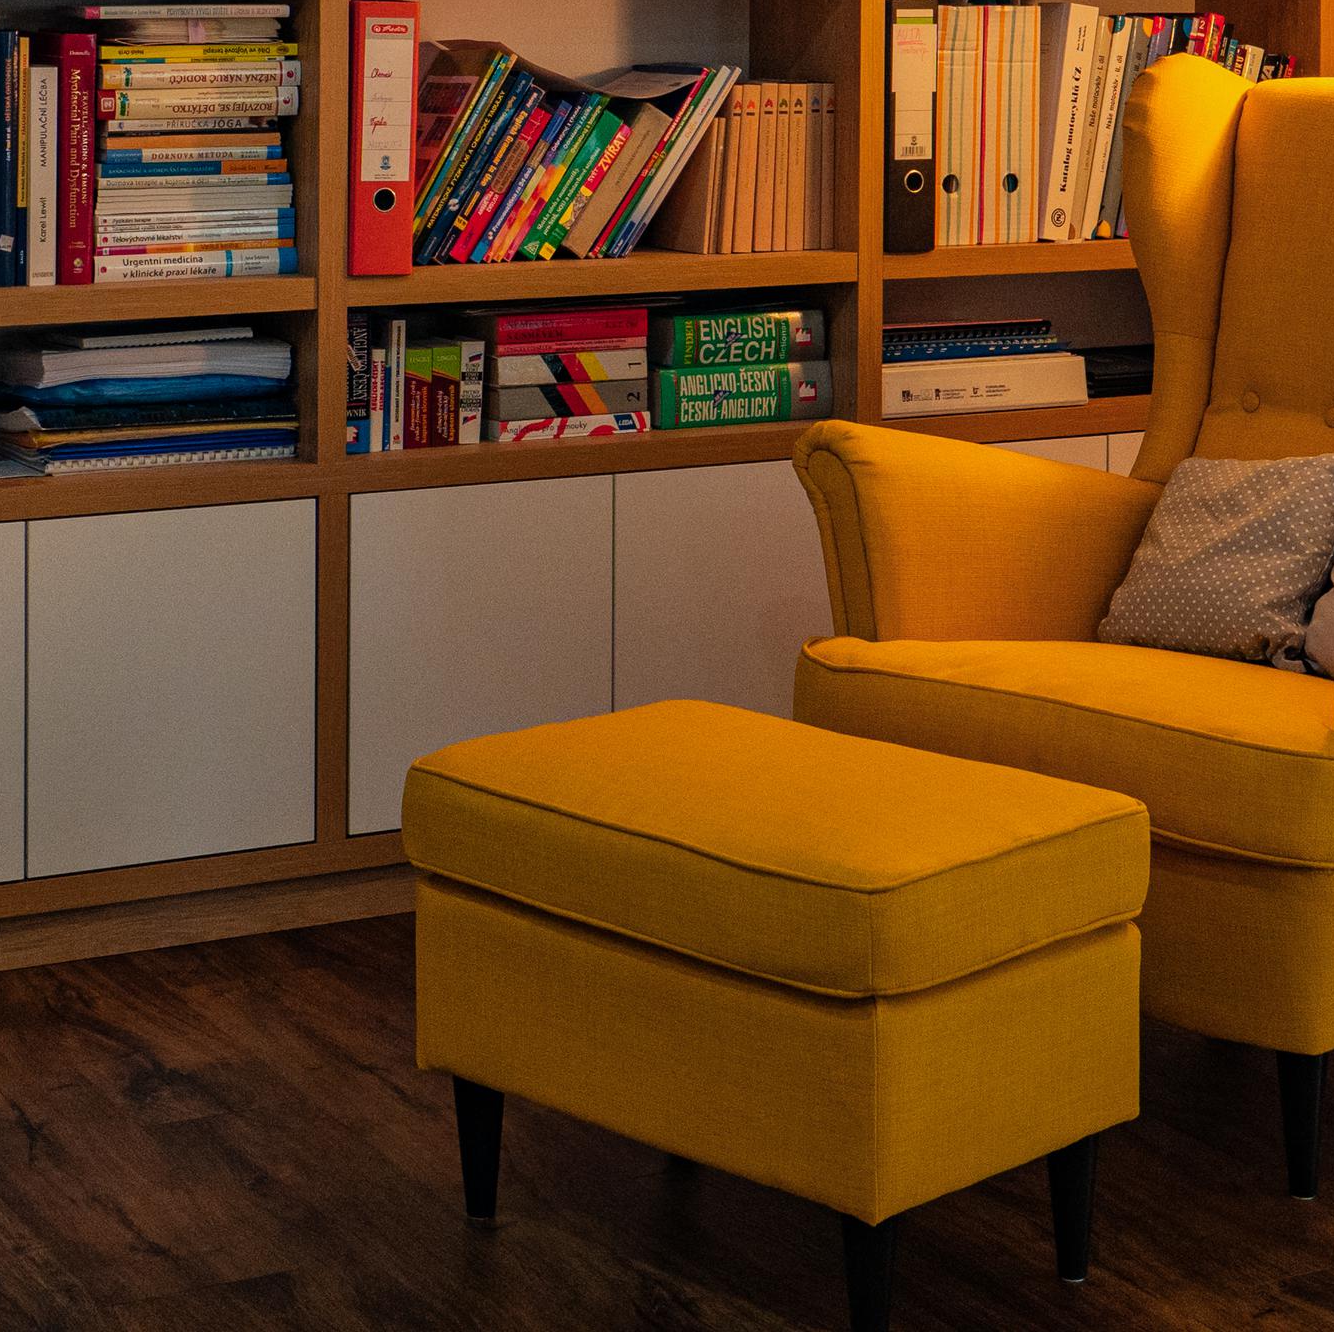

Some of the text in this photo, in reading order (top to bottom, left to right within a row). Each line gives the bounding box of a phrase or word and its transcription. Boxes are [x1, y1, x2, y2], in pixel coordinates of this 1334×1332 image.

[39, 78, 48, 167] MANIPULAČNÍ LÉČBA
[122, 255, 203, 267] Urgentní medicína
[130, 269, 164, 278] klinické
[166, 268, 188, 278] praxi
[190, 267, 216, 275] lékaře
[698, 317, 776, 342] ENGLISH
[698, 340, 776, 365] CZECH
[679, 368, 776, 395] ANGLICKO-ČESKÝ
